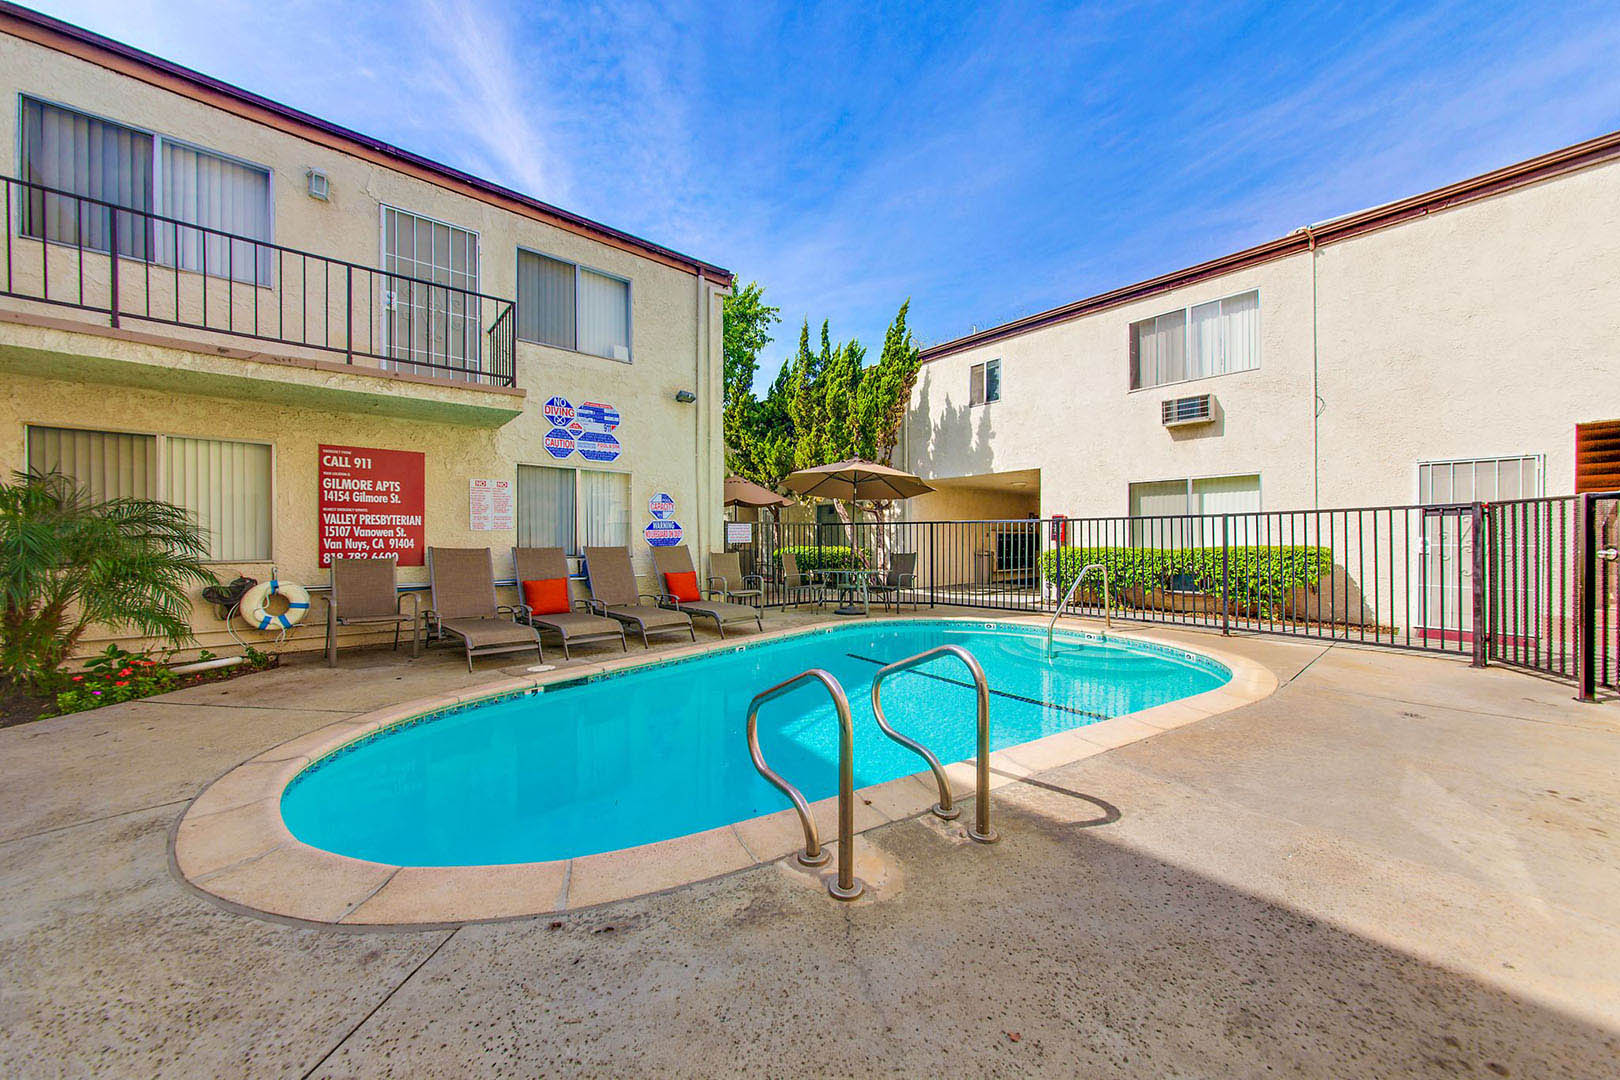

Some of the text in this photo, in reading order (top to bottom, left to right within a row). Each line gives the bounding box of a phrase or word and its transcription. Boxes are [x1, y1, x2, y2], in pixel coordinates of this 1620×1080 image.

[553, 397, 567, 407] NO
[544, 405, 575, 417] DIVING
[545, 438, 575, 449] CAUTION
[323, 455, 372, 469] CALL 911
[323, 478, 401, 492] GILMORE APTS
[324, 490, 401, 504] 14154 Gilmore St.
[323, 513, 422, 526] VALLEY PRESBYTERIAN
[324, 526, 407, 537] 15107 Vanowen St.
[323, 538, 415, 551] Van Nuys, CA 91404
